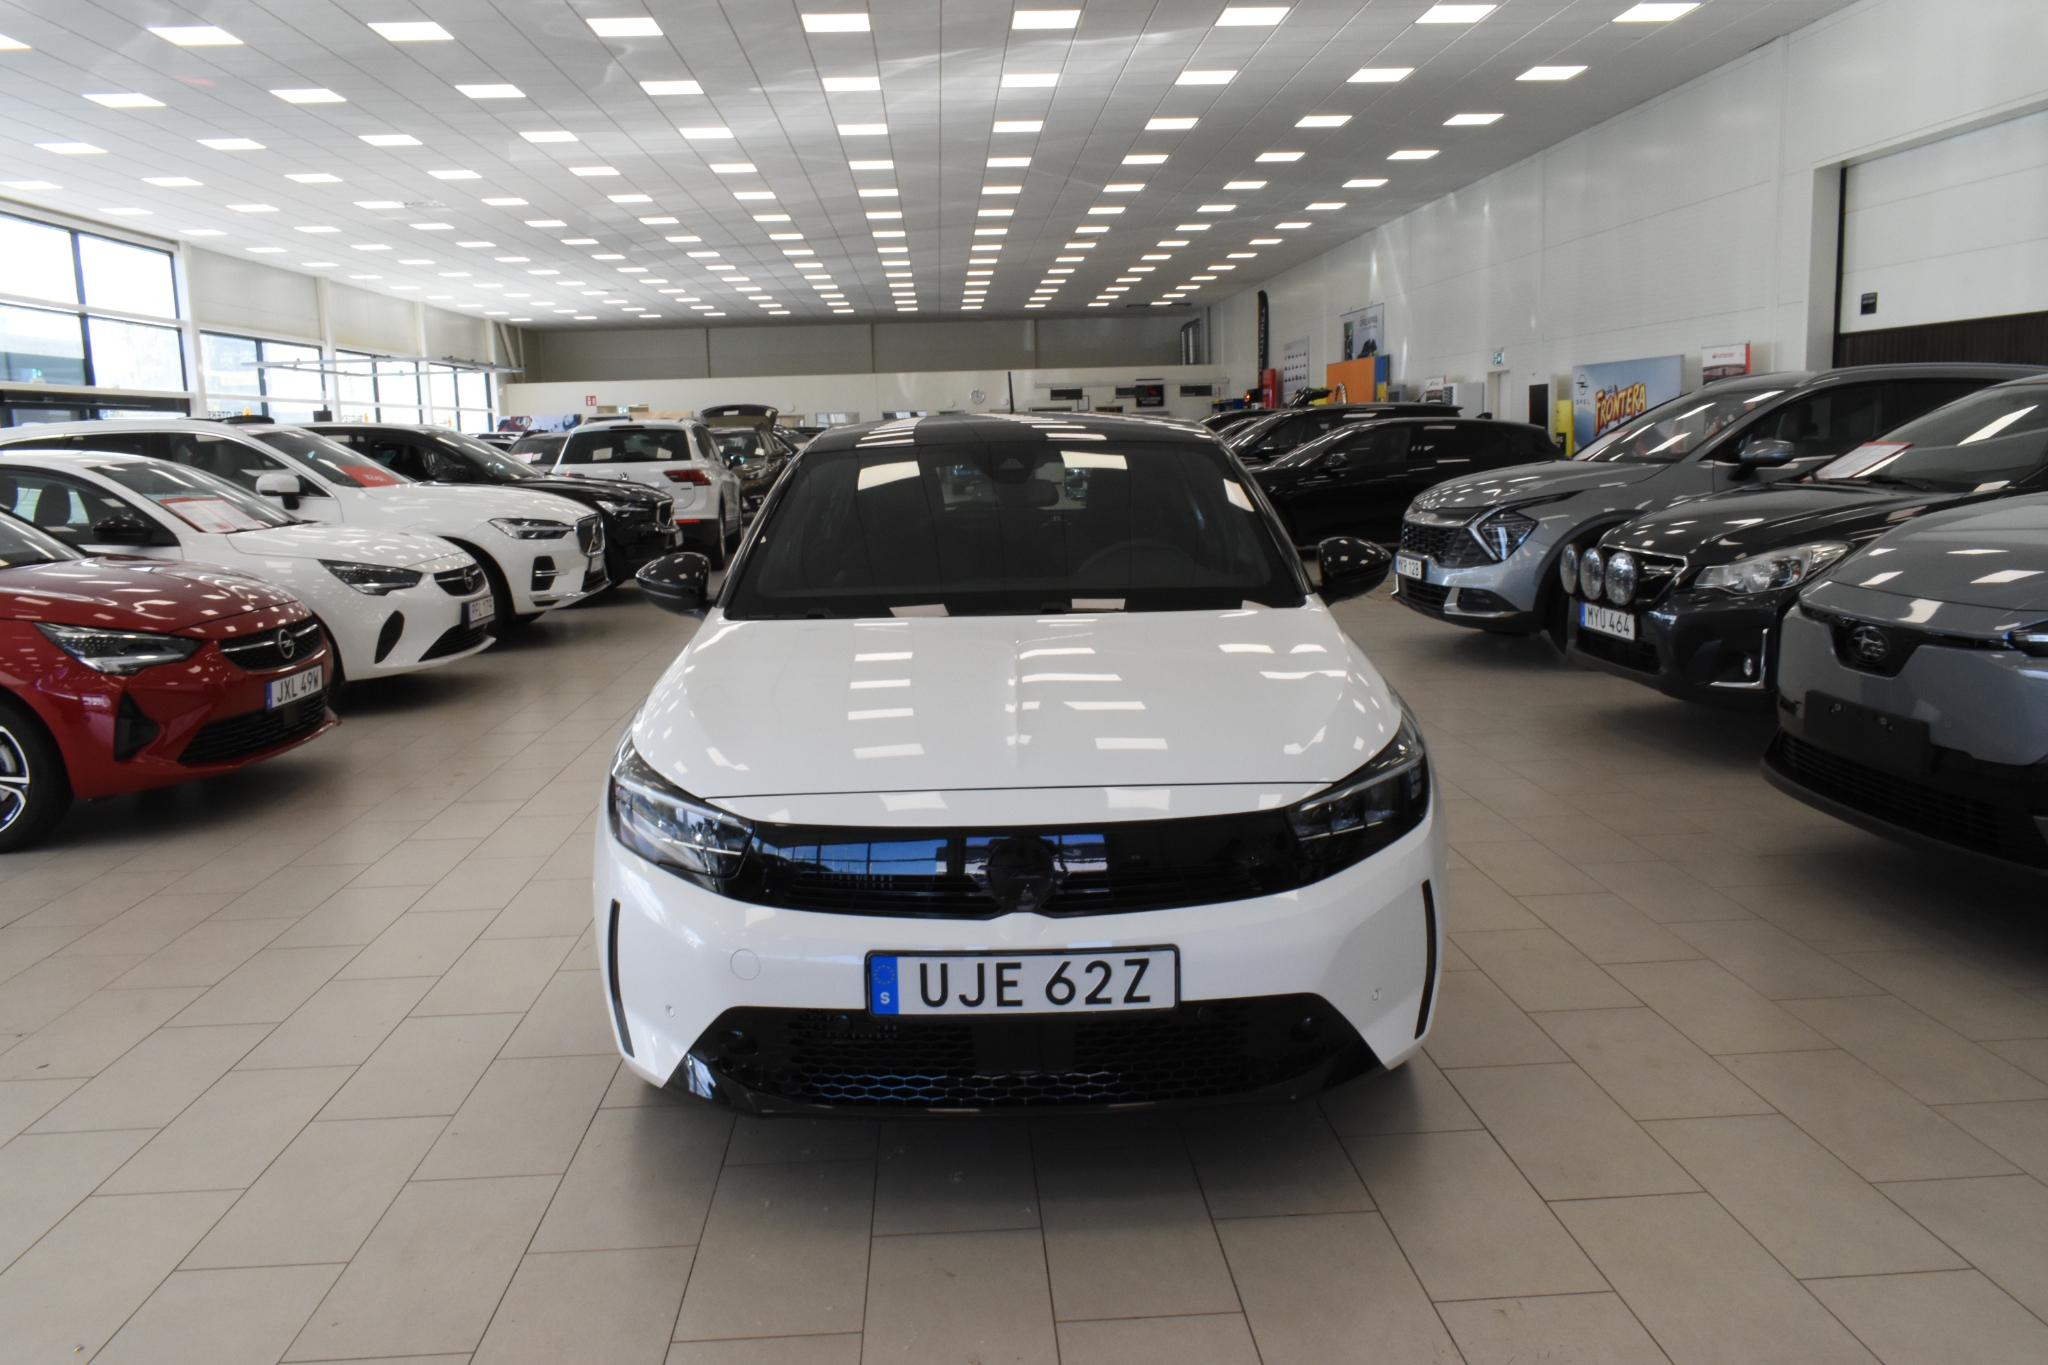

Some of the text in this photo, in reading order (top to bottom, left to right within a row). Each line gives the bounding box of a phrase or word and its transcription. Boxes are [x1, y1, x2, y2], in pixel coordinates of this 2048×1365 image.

[1594, 382, 1646, 436] FRONTERA
[1587, 605, 1629, 636] MYU 464
[277, 668, 319, 702] JXL 49W
[880, 992, 890, 1004] S
[919, 958, 1151, 1008] UJE 62Z
